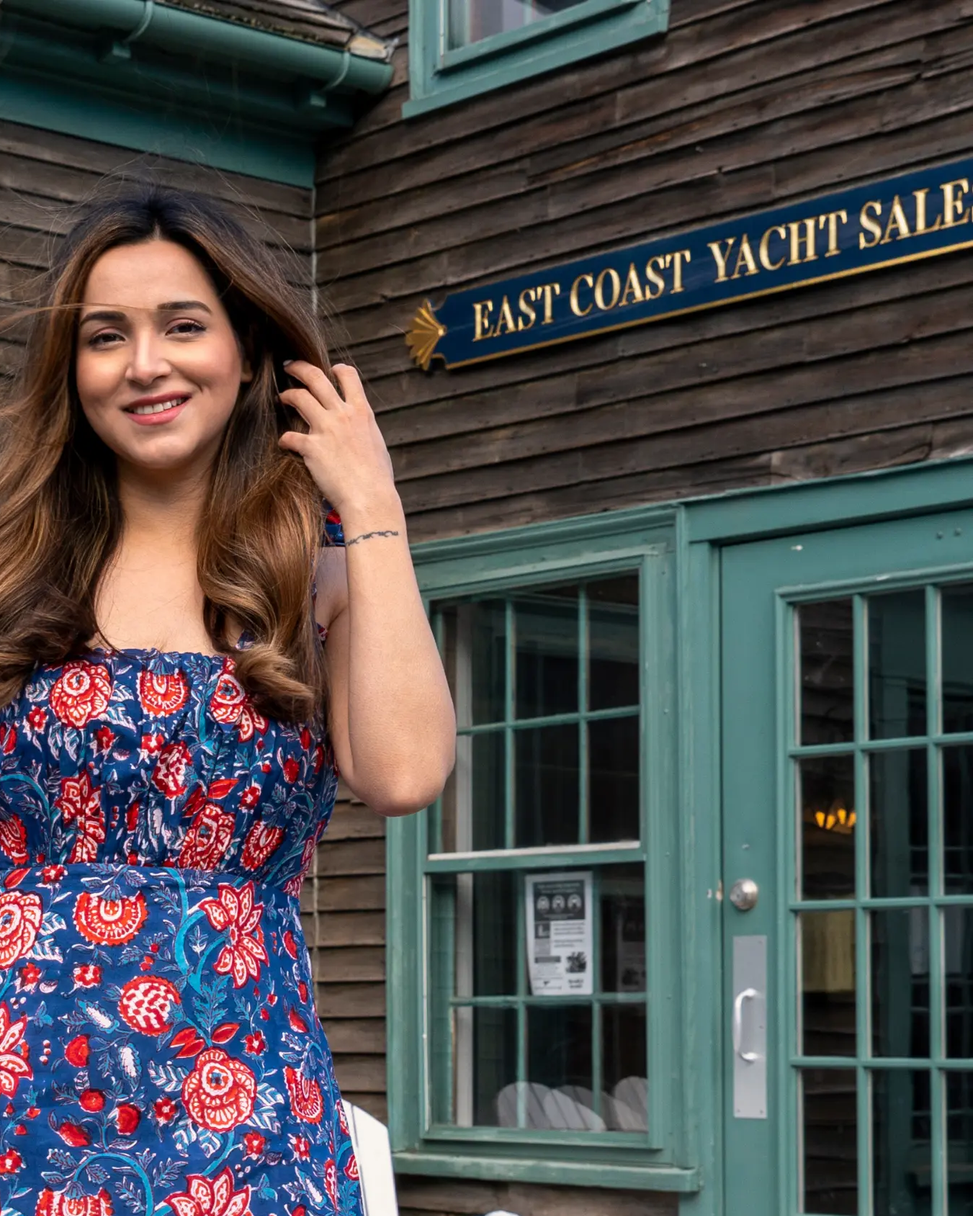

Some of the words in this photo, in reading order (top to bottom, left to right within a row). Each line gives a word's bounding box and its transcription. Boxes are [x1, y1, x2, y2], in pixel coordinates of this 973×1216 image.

[472, 281, 561, 343] EAST
[569, 249, 691, 317] COAST
[706, 208, 849, 284] YACHT
[858, 177, 973, 251] SALE
